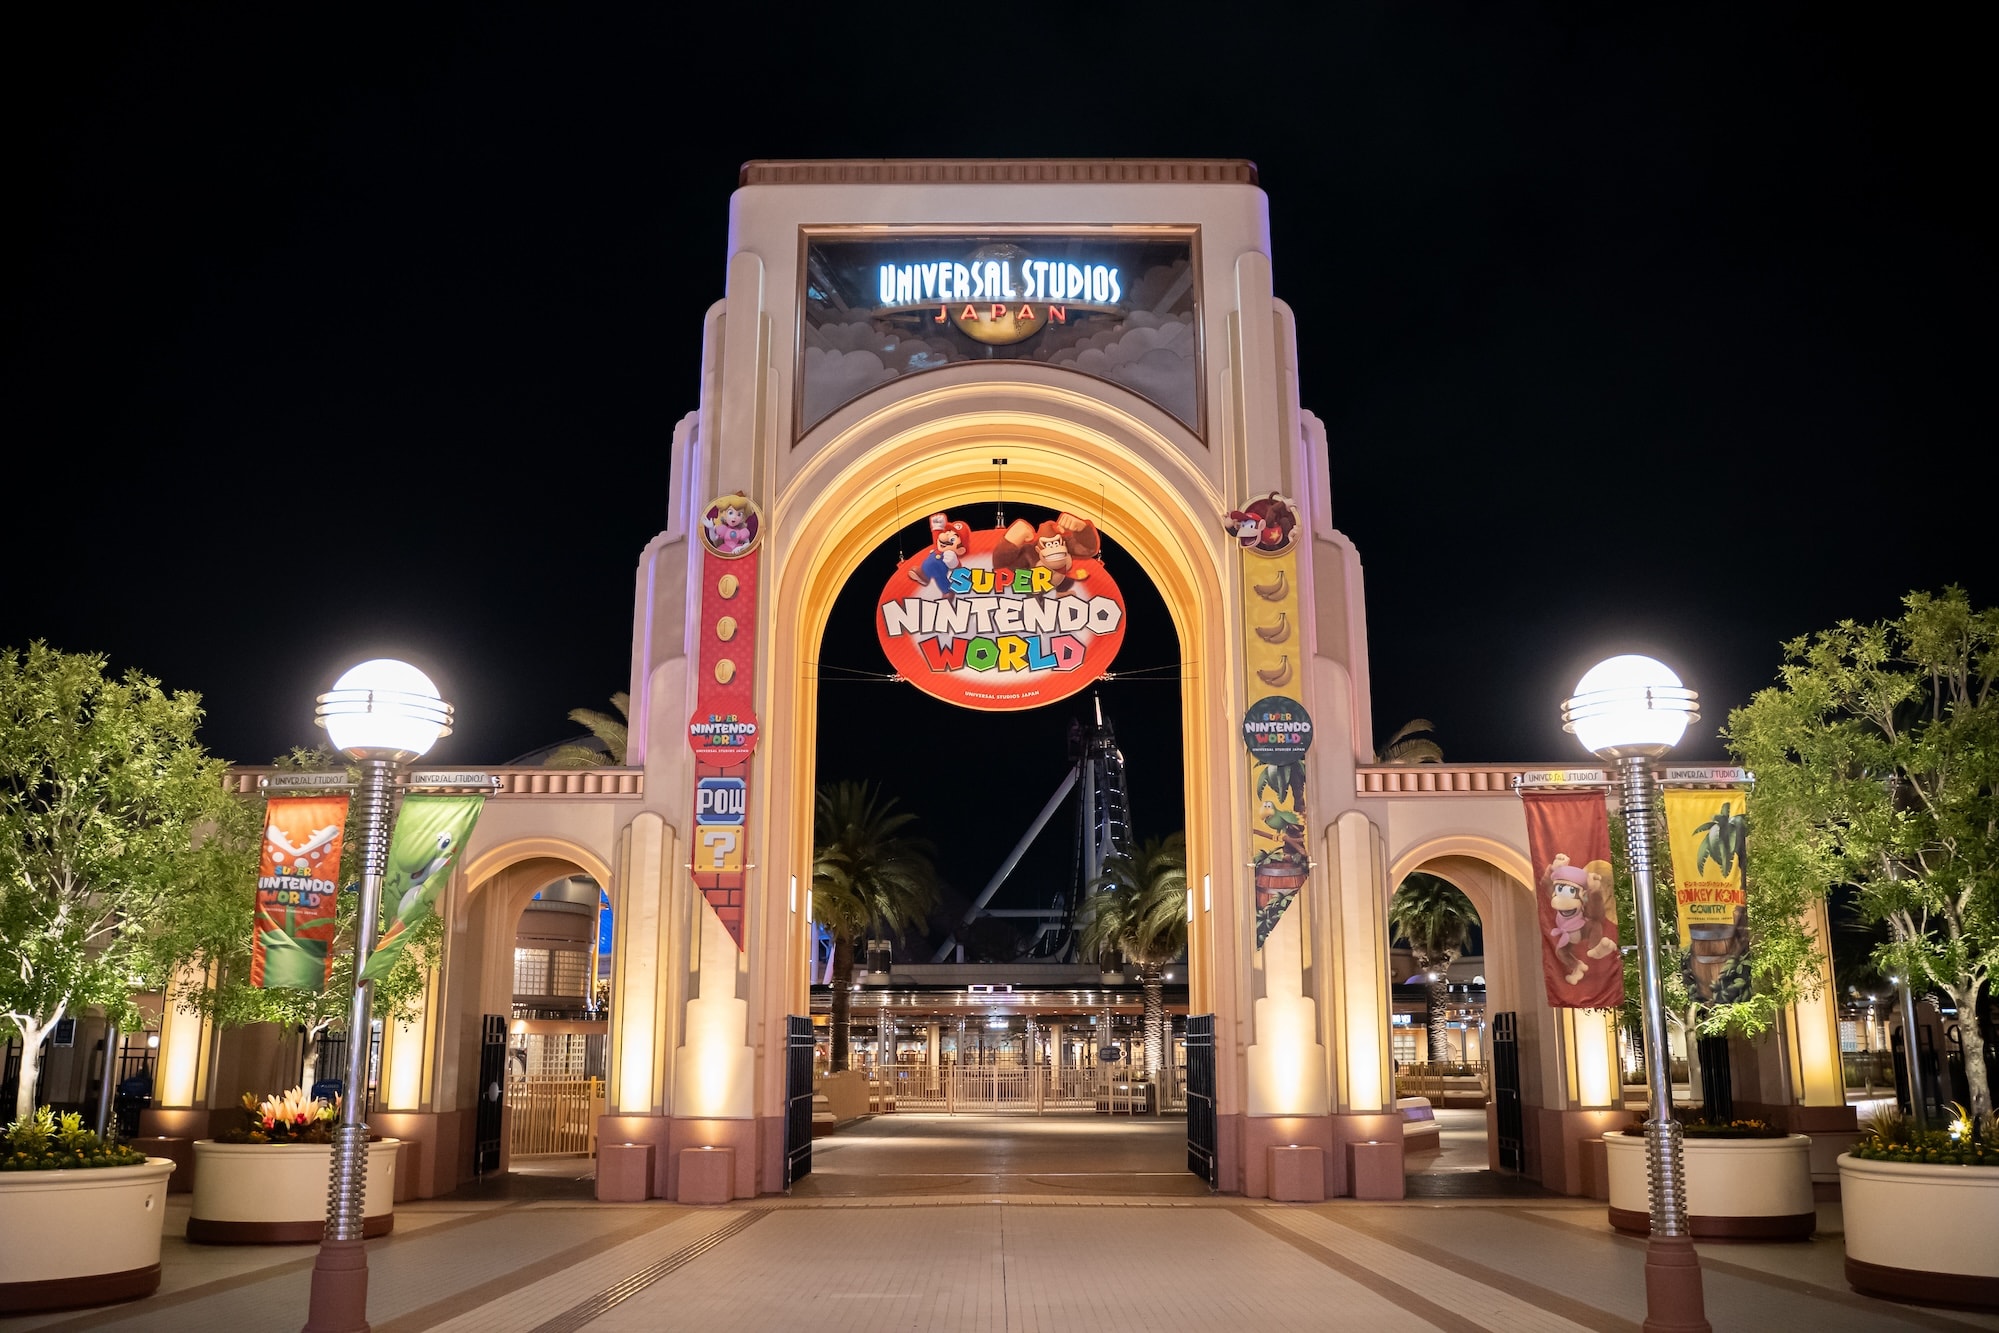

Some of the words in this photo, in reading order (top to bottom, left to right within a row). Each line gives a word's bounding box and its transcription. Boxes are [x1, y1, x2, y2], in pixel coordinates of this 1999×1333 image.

[880, 261, 1016, 303] UNIVERSAL
[1022, 259, 1121, 303] STUDIOS
[934, 304, 1067, 324] JAPAN
[949, 566, 1054, 593] SUPER
[881, 595, 1123, 637] NINTENDO
[919, 634, 1086, 672] WORLD
[964, 691, 995, 699] UNIVERSAL
[1021, 690, 1040, 698] JAPAN
[709, 714, 738, 723] SUER
[1263, 713, 1292, 721] SUPER
[690, 723, 756, 734] NINTENDO
[1245, 722, 1311, 733] NINTENDO
[1255, 733, 1301, 744] WORLD
[275, 776, 312, 785] UNIVERSAL
[312, 775, 344, 785] STUDIOS
[415, 775, 452, 783] UNIVERSAL
[453, 774, 485, 783] STUDIOS
[1529, 773, 1566, 782] UNIVERSAL
[1567, 772, 1599, 781] STUDIOS
[1671, 771, 1709, 780] UNIVERSAL
[1710, 769, 1740, 779] STUDIOS
[697, 788, 746, 815] POW
[275, 865, 312, 877] SUPER
[260, 890, 320, 907] WORLD
[1677, 889, 1712, 905] ONKEY
[1690, 904, 1726, 914] COUNTRY
